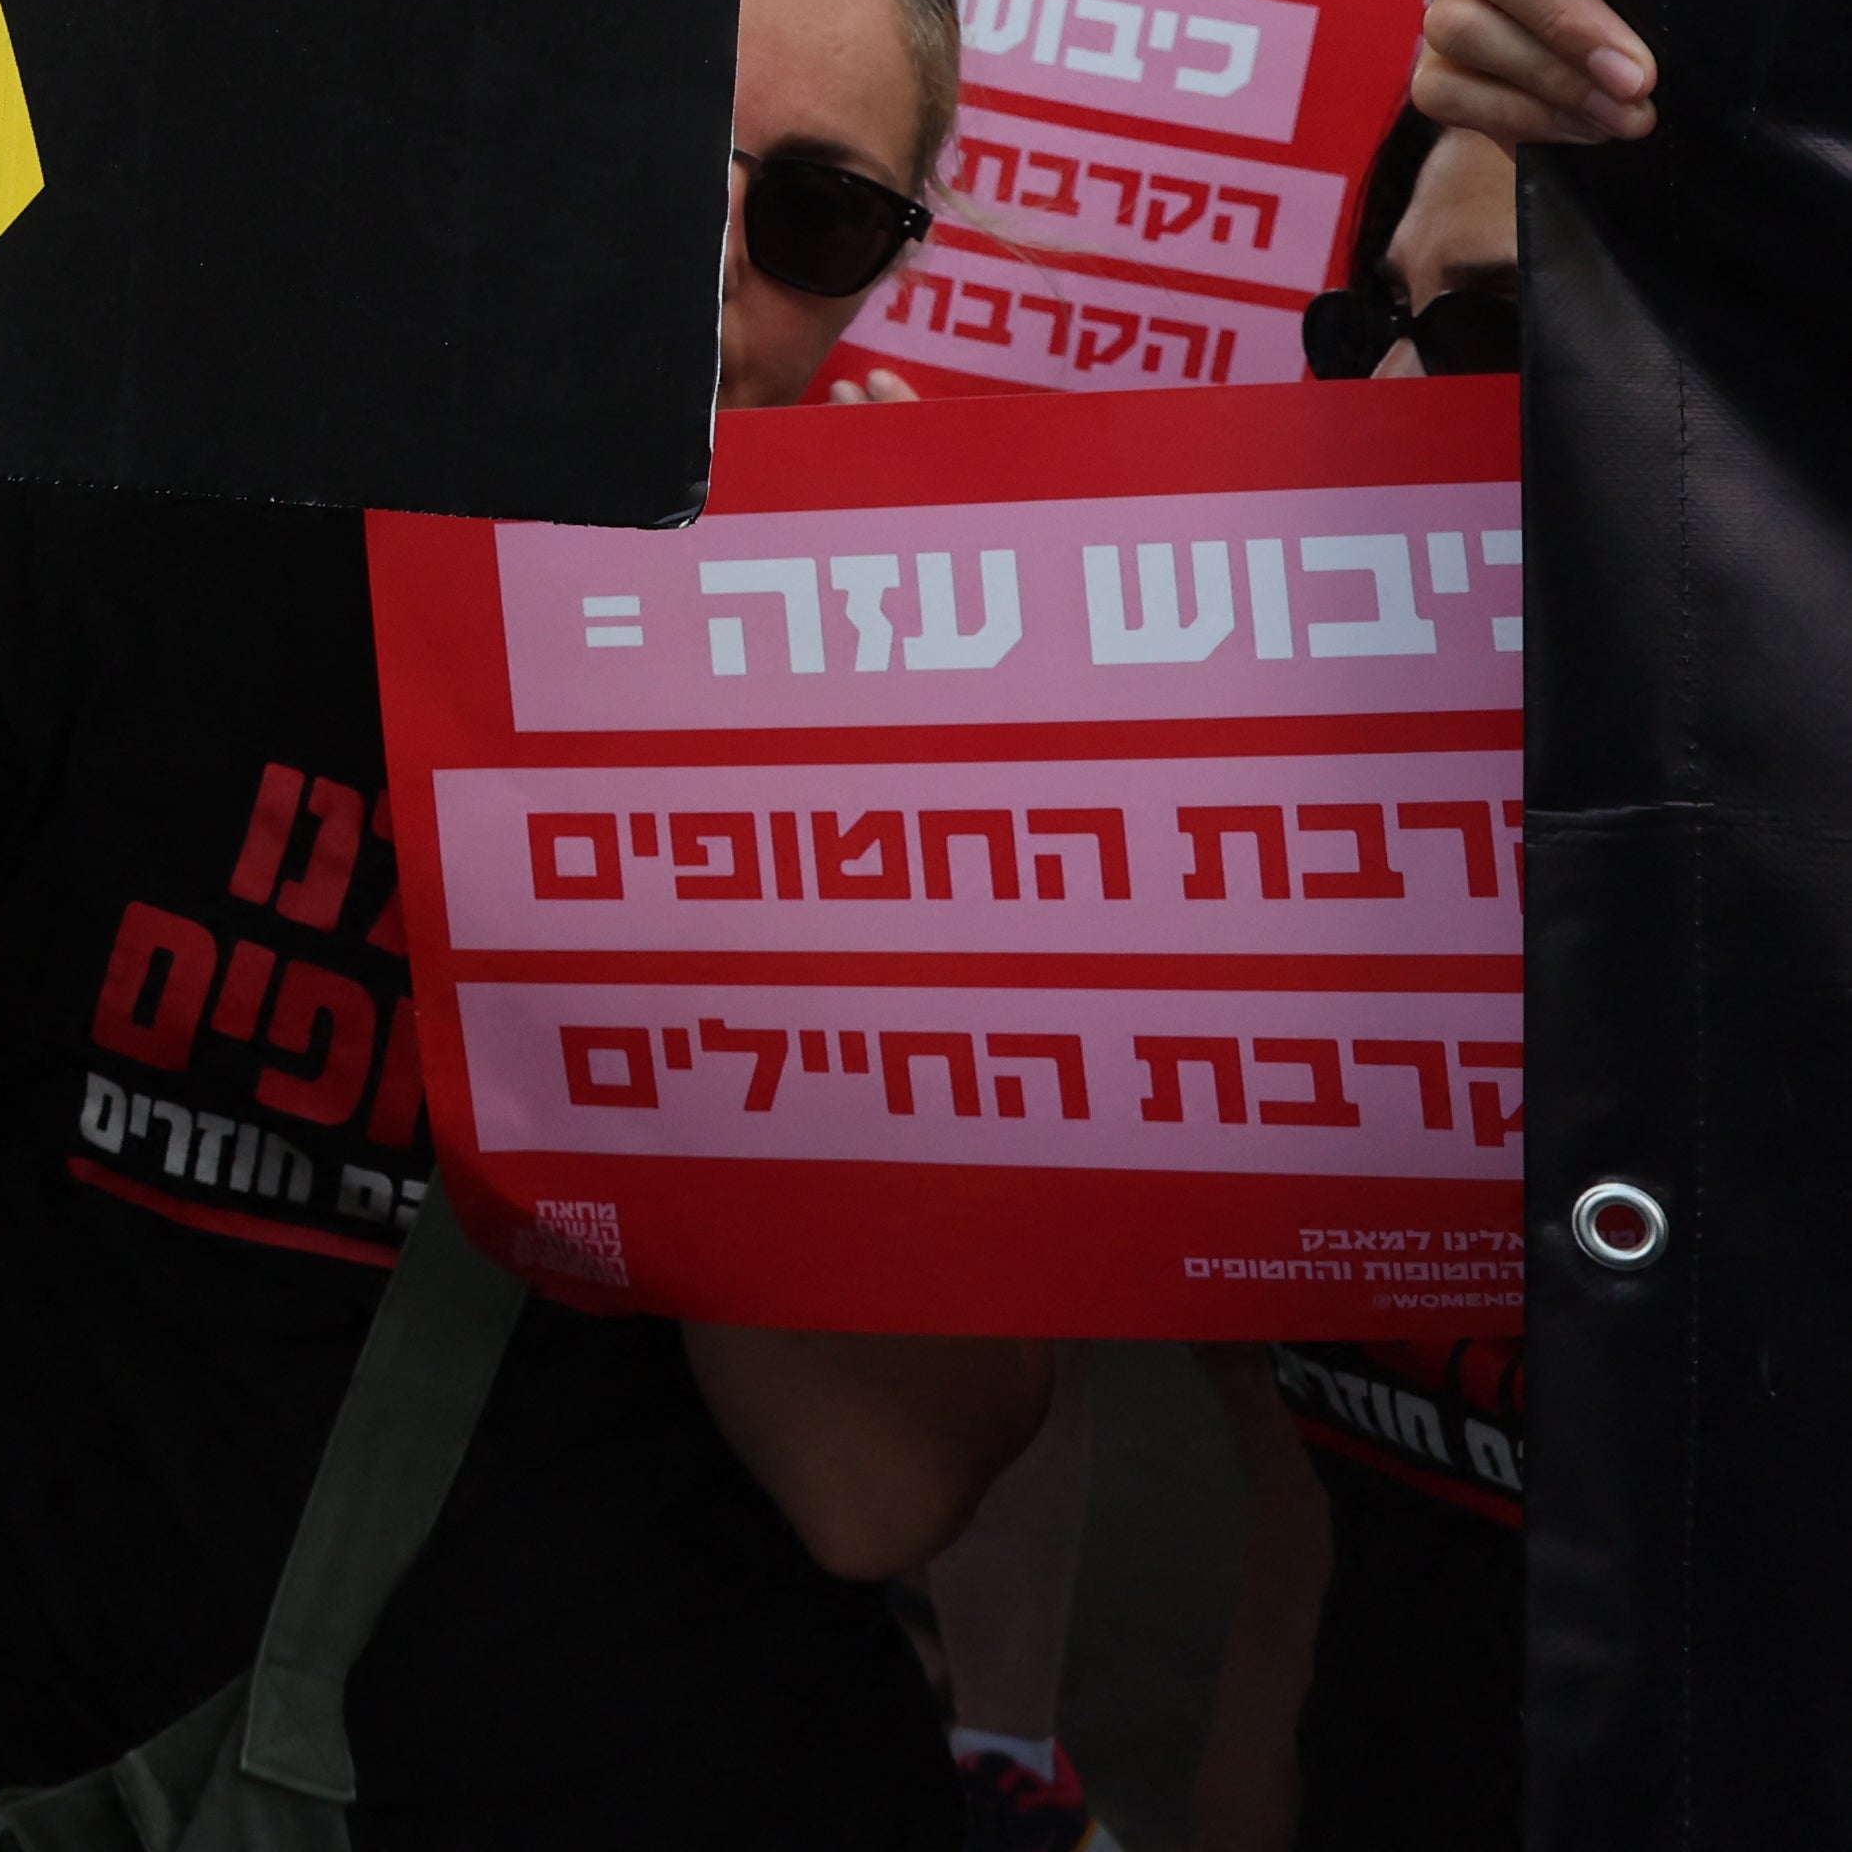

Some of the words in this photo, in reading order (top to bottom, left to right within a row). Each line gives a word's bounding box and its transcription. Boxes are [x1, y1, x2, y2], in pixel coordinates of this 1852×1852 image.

[952, 134, 1281, 251] הקרבת
[886, 269, 1237, 385] והקרבת
[699, 548, 1023, 676] עזה
[526, 807, 1132, 902] החטופים
[1177, 799, 1524, 915] רבת
[559, 1017, 1091, 1121] החיילים
[80, 1072, 314, 1204] חוזרים
[535, 1199, 617, 1221] מחאת
[1299, 1228, 1432, 1253] למאבק
[1183, 1257, 1352, 1281] והחטופים
